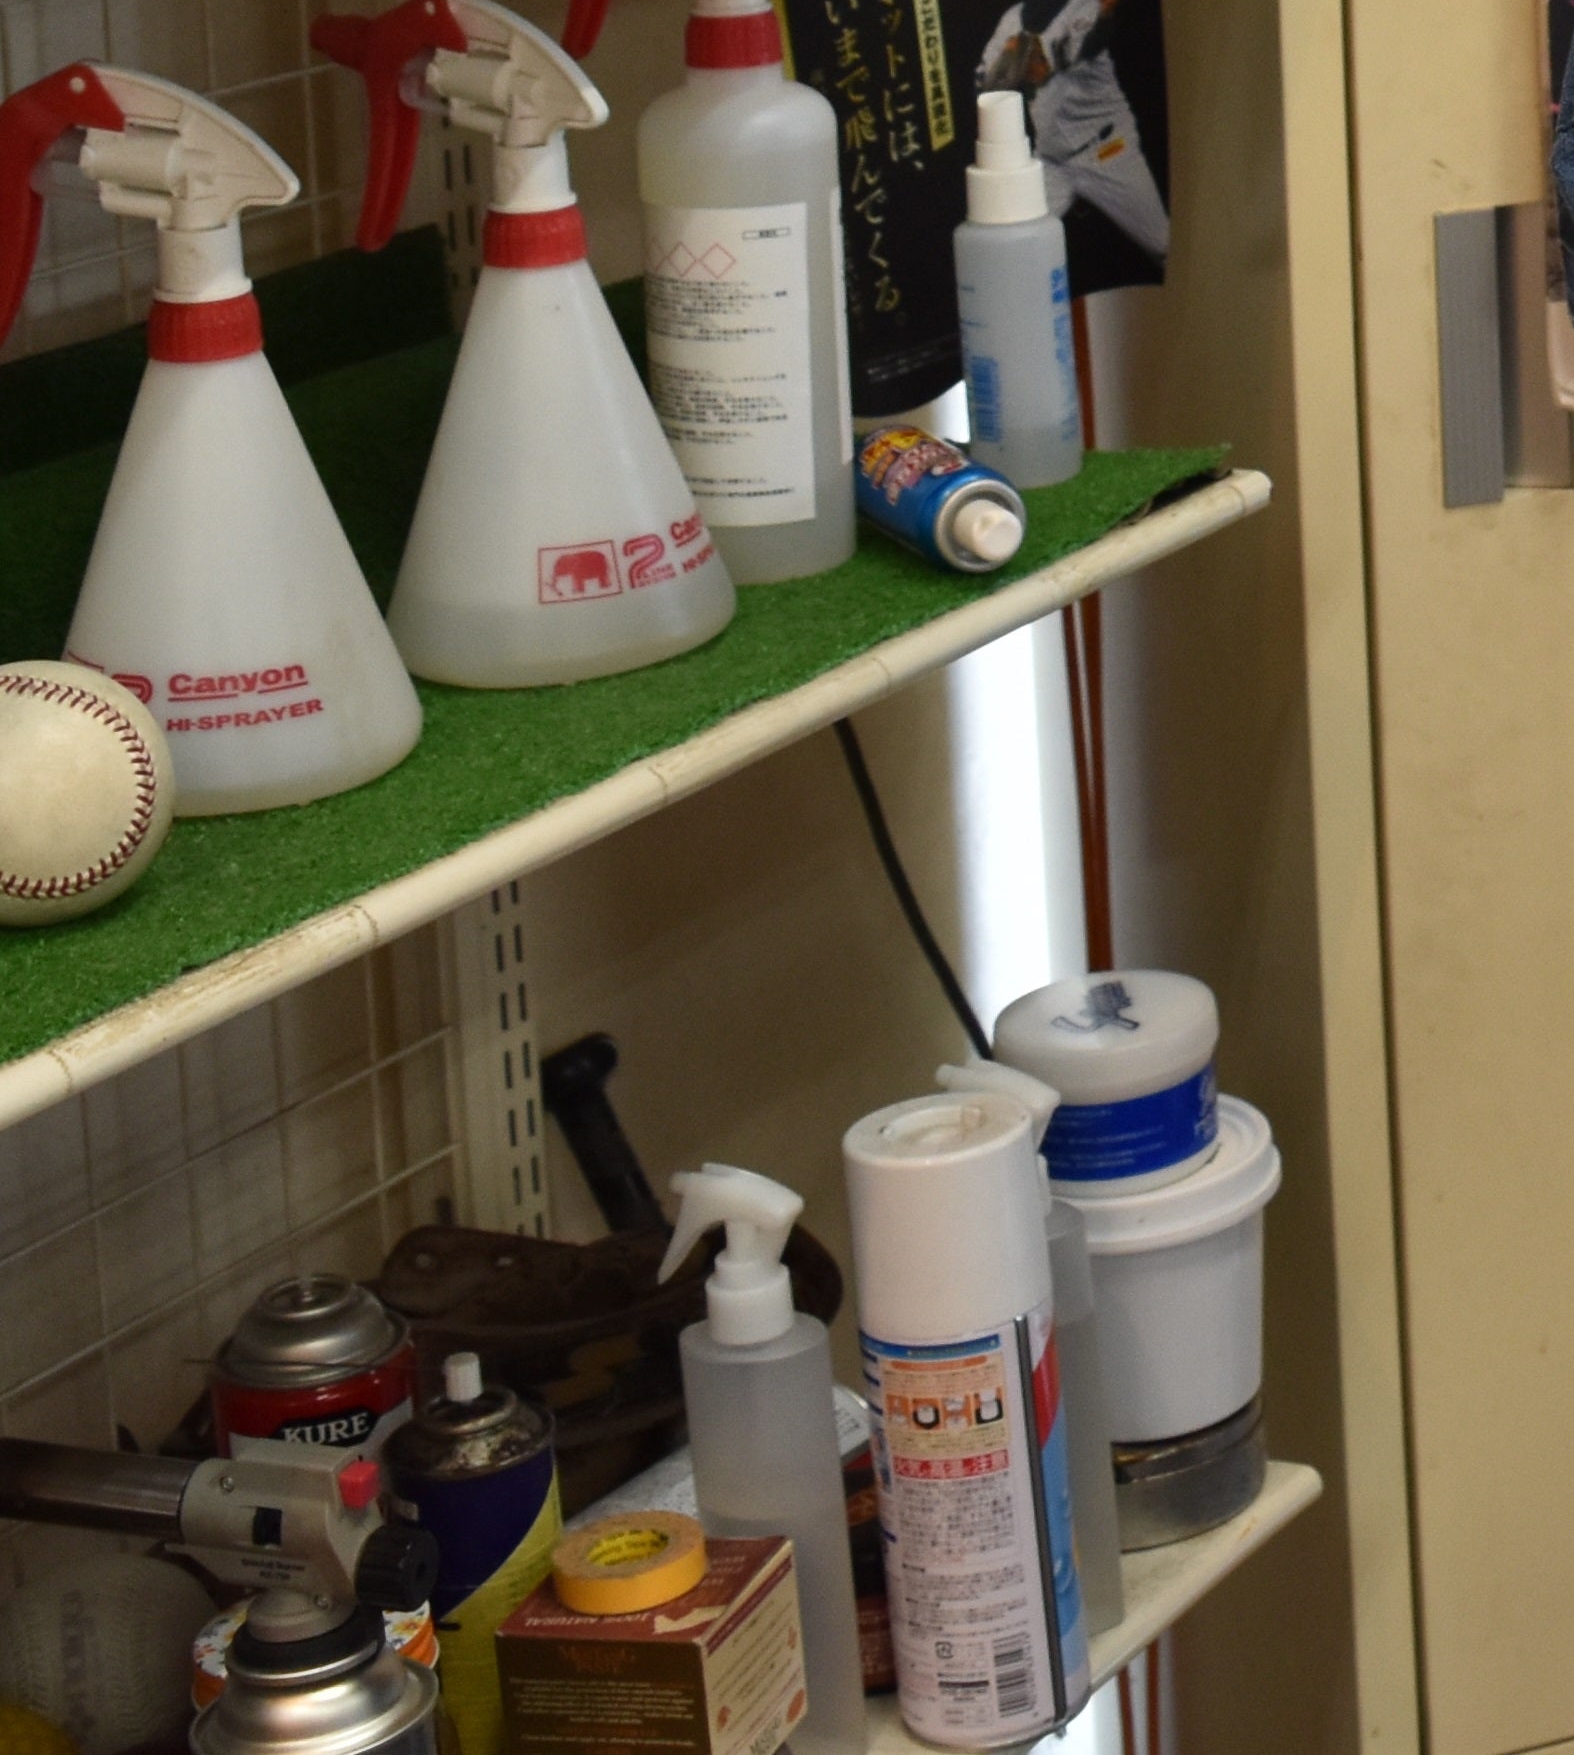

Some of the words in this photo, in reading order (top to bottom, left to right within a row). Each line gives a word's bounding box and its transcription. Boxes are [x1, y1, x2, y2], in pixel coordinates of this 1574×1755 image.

[167, 663, 307, 694] Canyon
[166, 697, 325, 732] HI-SPRAYER
[282, 1411, 370, 1445] KURE
